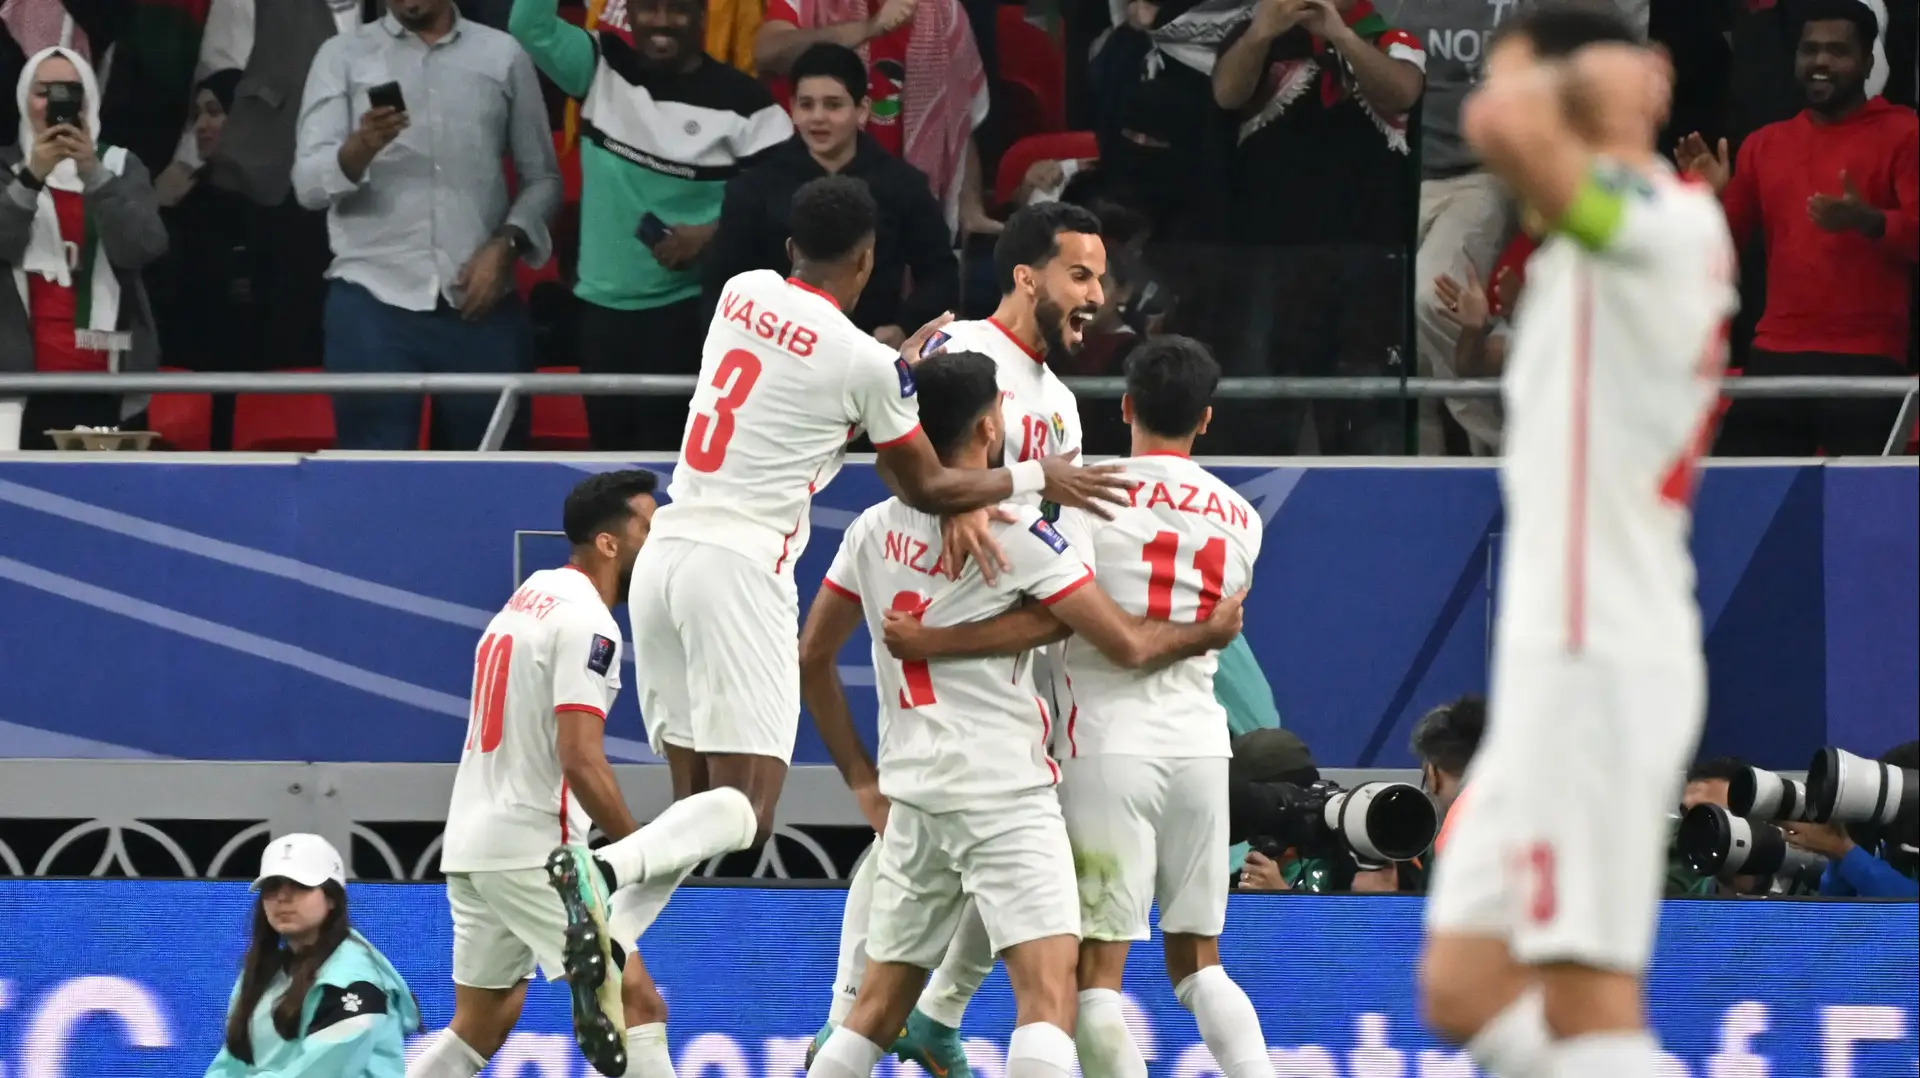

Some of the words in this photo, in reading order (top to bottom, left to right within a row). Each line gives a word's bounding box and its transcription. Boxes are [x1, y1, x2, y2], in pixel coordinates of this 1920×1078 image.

[720, 290, 819, 358] NASIB
[685, 348, 762, 473] 3
[1017, 415, 1049, 463] 13
[1125, 481, 1249, 530] YAZAN
[884, 530, 943, 577] NIZ
[1142, 530, 1227, 624] 11
[467, 633, 514, 753] 10
[843, 985, 857, 997] JA
